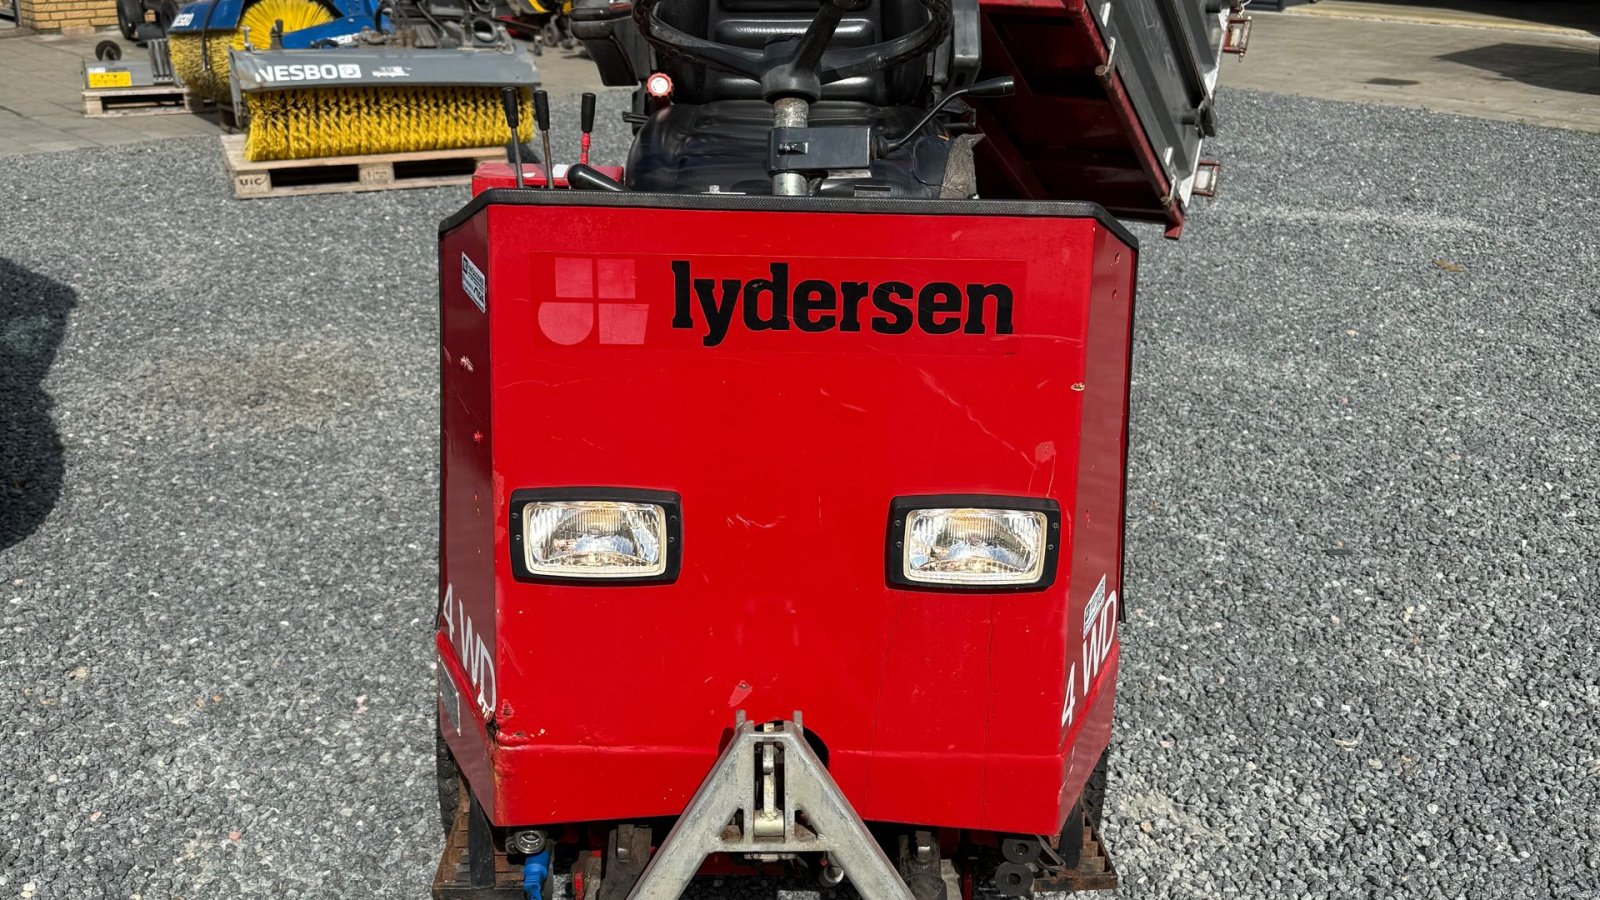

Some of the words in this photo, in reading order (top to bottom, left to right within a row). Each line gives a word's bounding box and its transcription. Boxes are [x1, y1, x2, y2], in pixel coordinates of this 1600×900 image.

[255, 64, 337, 82] NESBO
[671, 260, 1013, 347] lydersen
[443, 583, 454, 643] 4
[458, 598, 497, 714] WD
[1061, 662, 1076, 727] 4
[1082, 590, 1117, 697] WD
